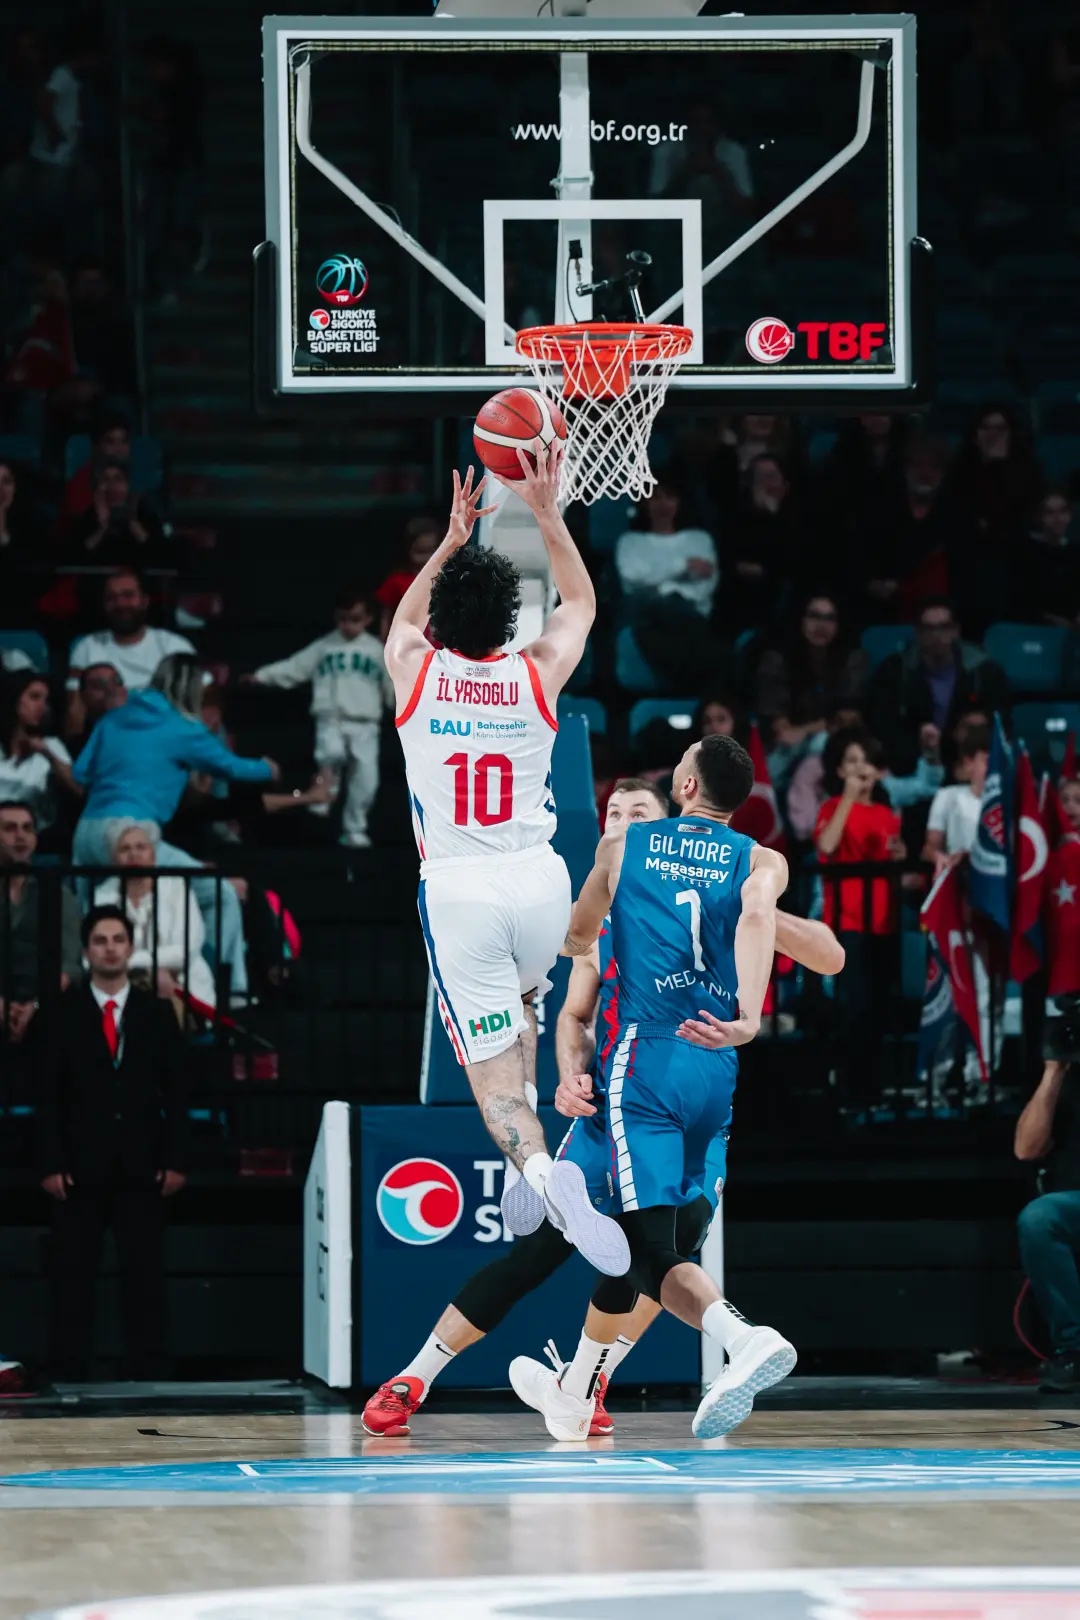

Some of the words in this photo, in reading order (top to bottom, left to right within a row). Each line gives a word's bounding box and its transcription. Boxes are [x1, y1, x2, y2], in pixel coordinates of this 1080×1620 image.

[510, 120, 688, 145] wwwbf.org.tr
[307, 330, 380, 341] BASKETBOL
[310, 341, 351, 353] SÜPER
[353, 341, 377, 352] LİGİ
[797, 322, 886, 360] TBF
[430, 718, 471, 737] BAU
[477, 720, 527, 731] Bahçeşehir
[443, 752, 513, 827] 10
[649, 833, 732, 864] GILMORE
[645, 857, 729, 884] Megasaray
[661, 874, 711, 889] HOTELS
[468, 1009, 512, 1037] HDI
